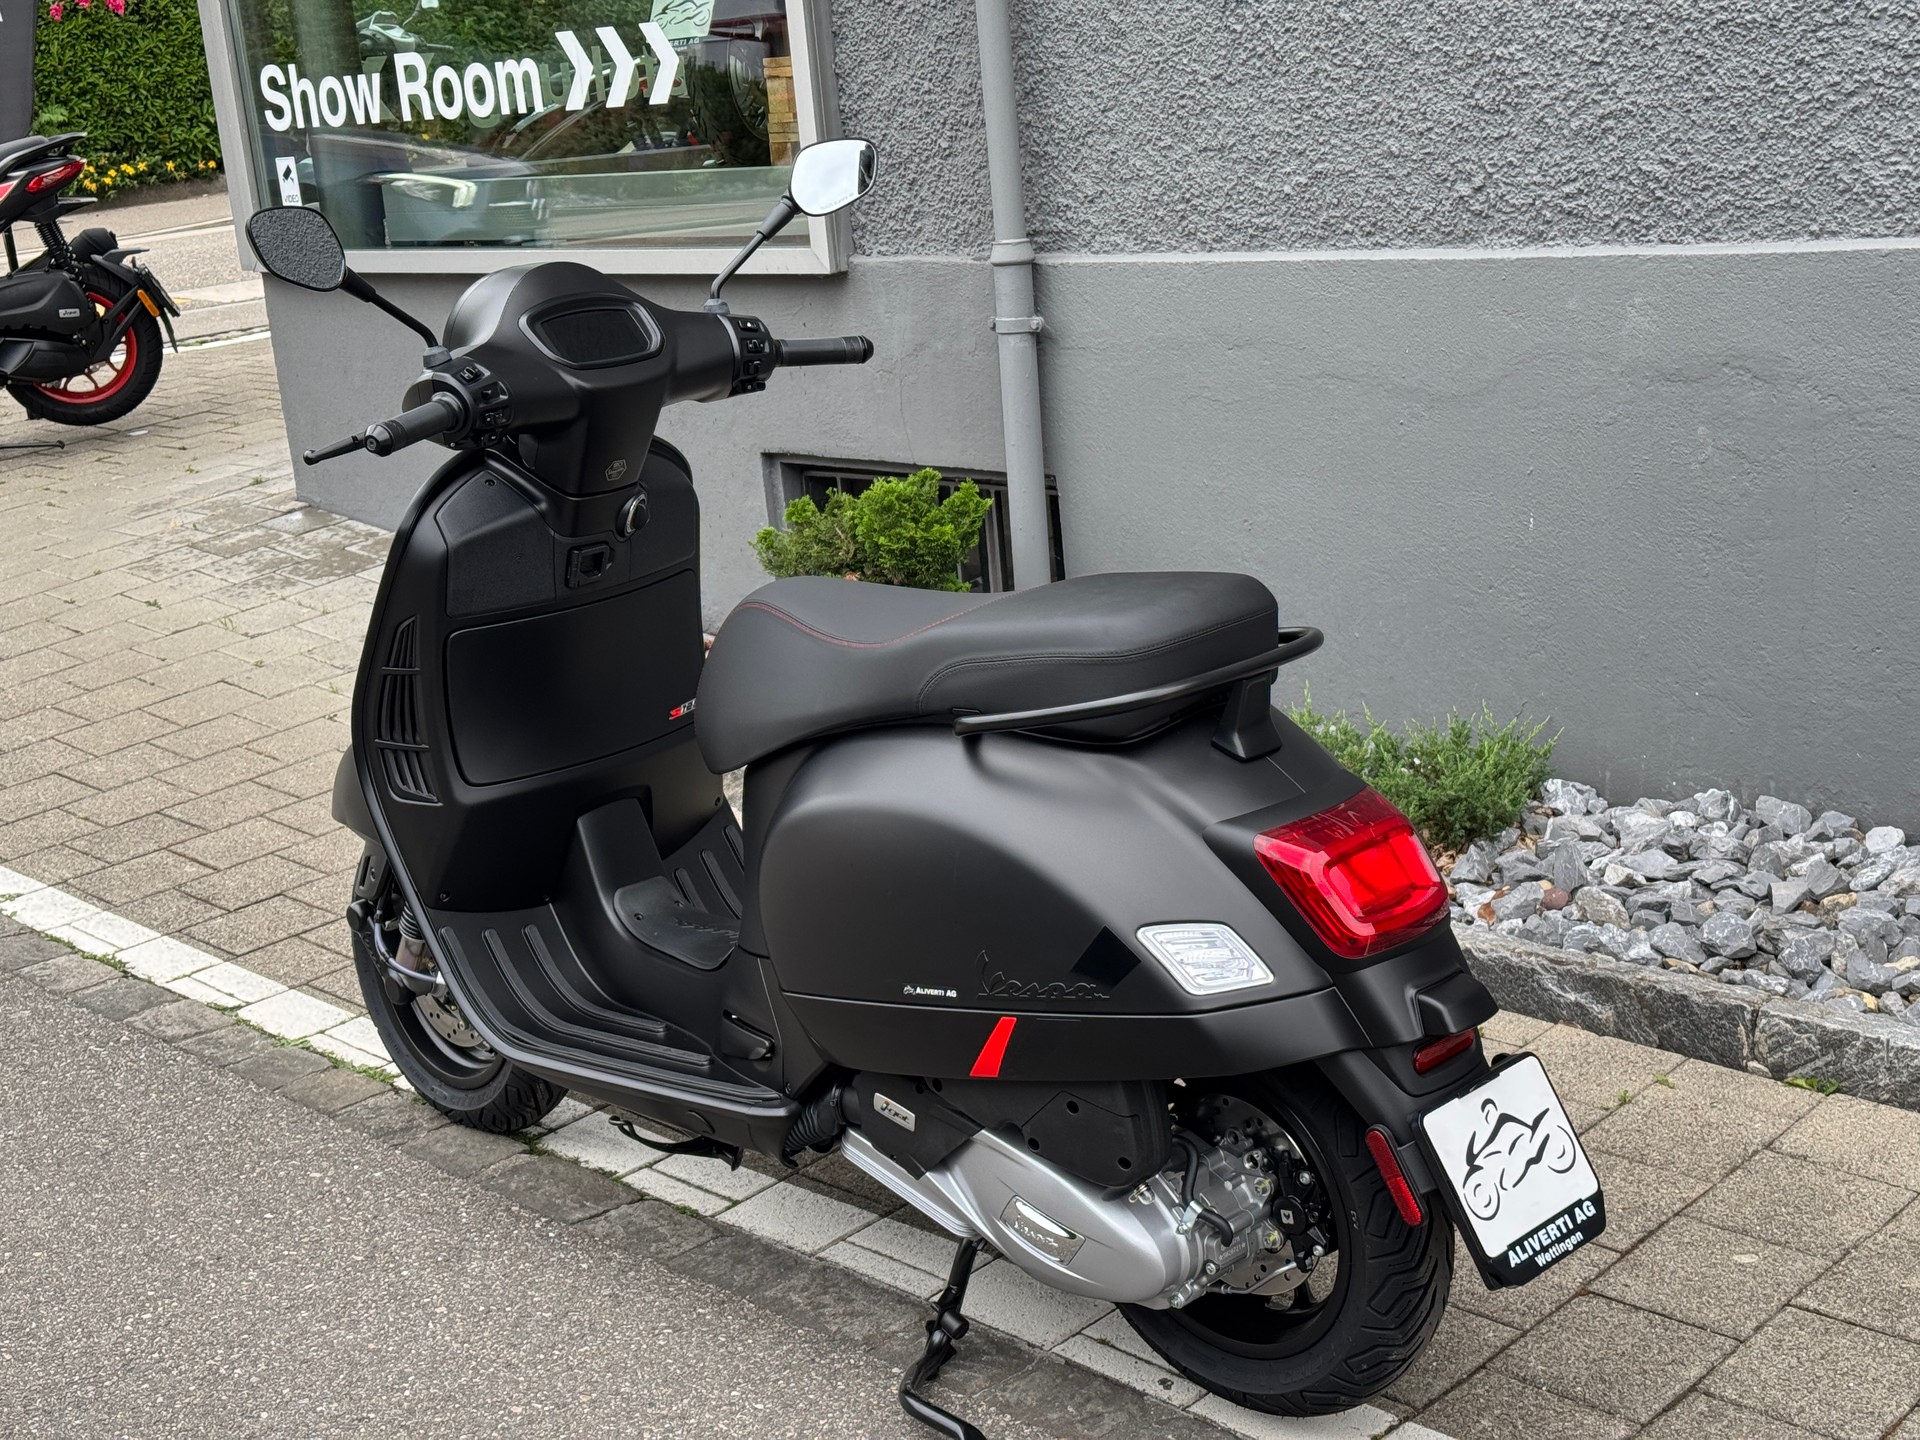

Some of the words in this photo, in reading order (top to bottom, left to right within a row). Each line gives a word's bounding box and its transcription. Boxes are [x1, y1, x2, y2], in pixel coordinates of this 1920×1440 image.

[687, 37, 700, 45] AG
[260, 63, 381, 132] Show
[393, 51, 545, 122] Room
[285, 194, 299, 203] VIDEO
[915, 986, 945, 997] ALIVERTI
[946, 989, 957, 998] AG
[975, 949, 1110, 1001] Vespa
[1507, 1213, 1574, 1268] ALIVERTI
[1574, 1200, 1597, 1225] AG
[1534, 1231, 1584, 1267] Wettingen
